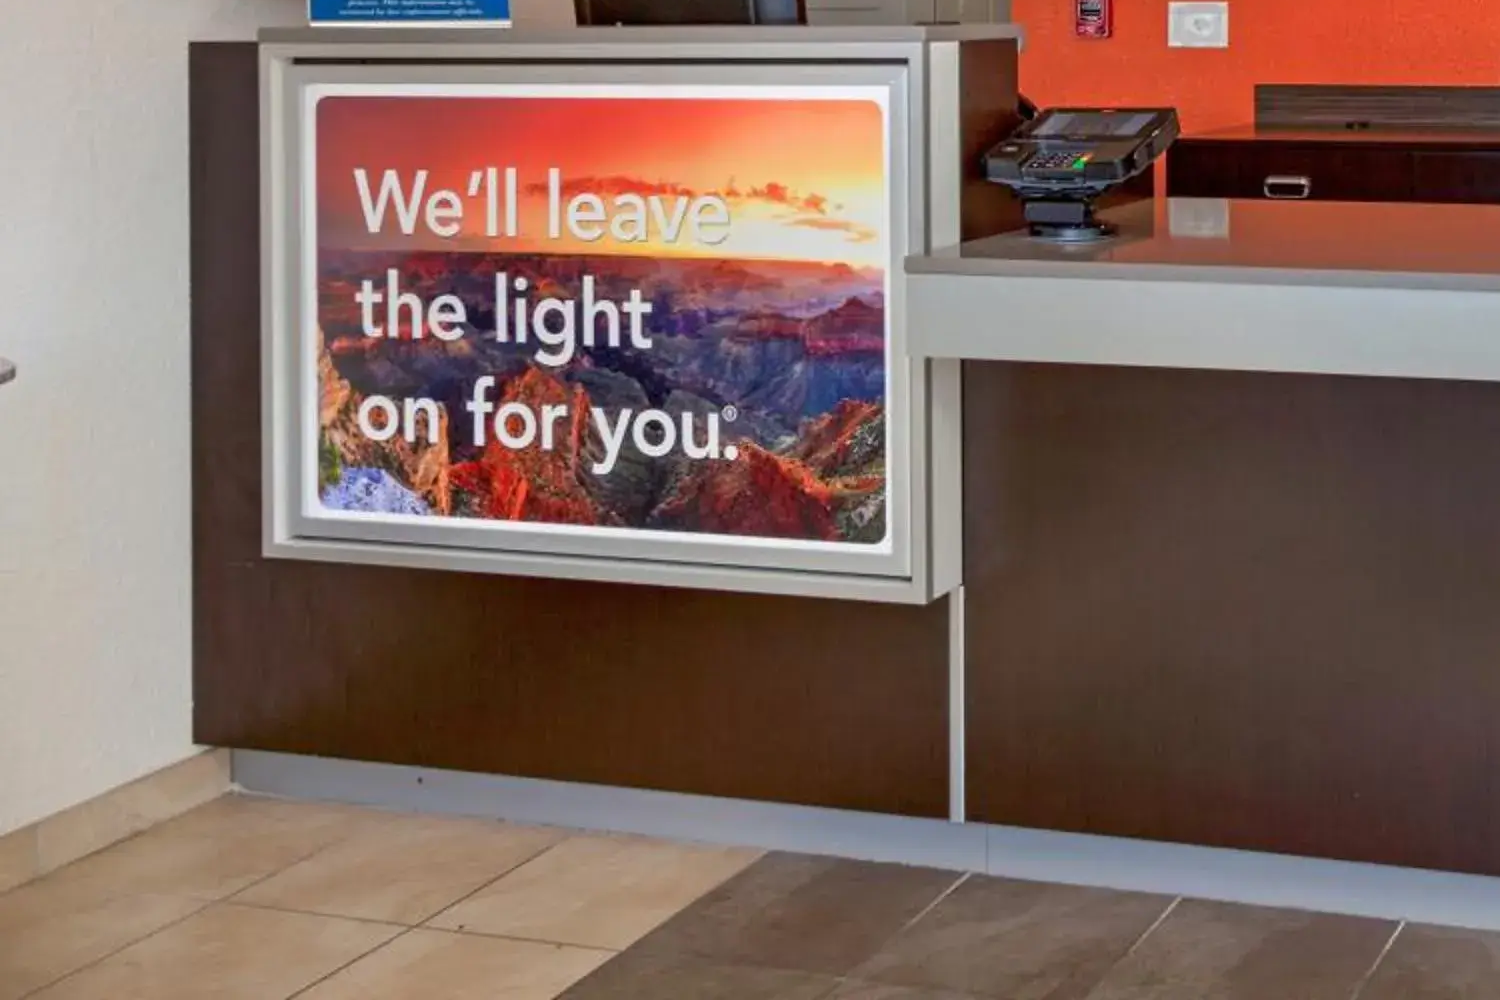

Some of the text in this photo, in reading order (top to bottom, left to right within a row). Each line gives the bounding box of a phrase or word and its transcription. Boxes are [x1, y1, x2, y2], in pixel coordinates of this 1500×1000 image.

[353, 166, 731, 245] We'll leave
[354, 268, 654, 367] the light
[357, 391, 440, 445] on
[465, 374, 567, 450] for
